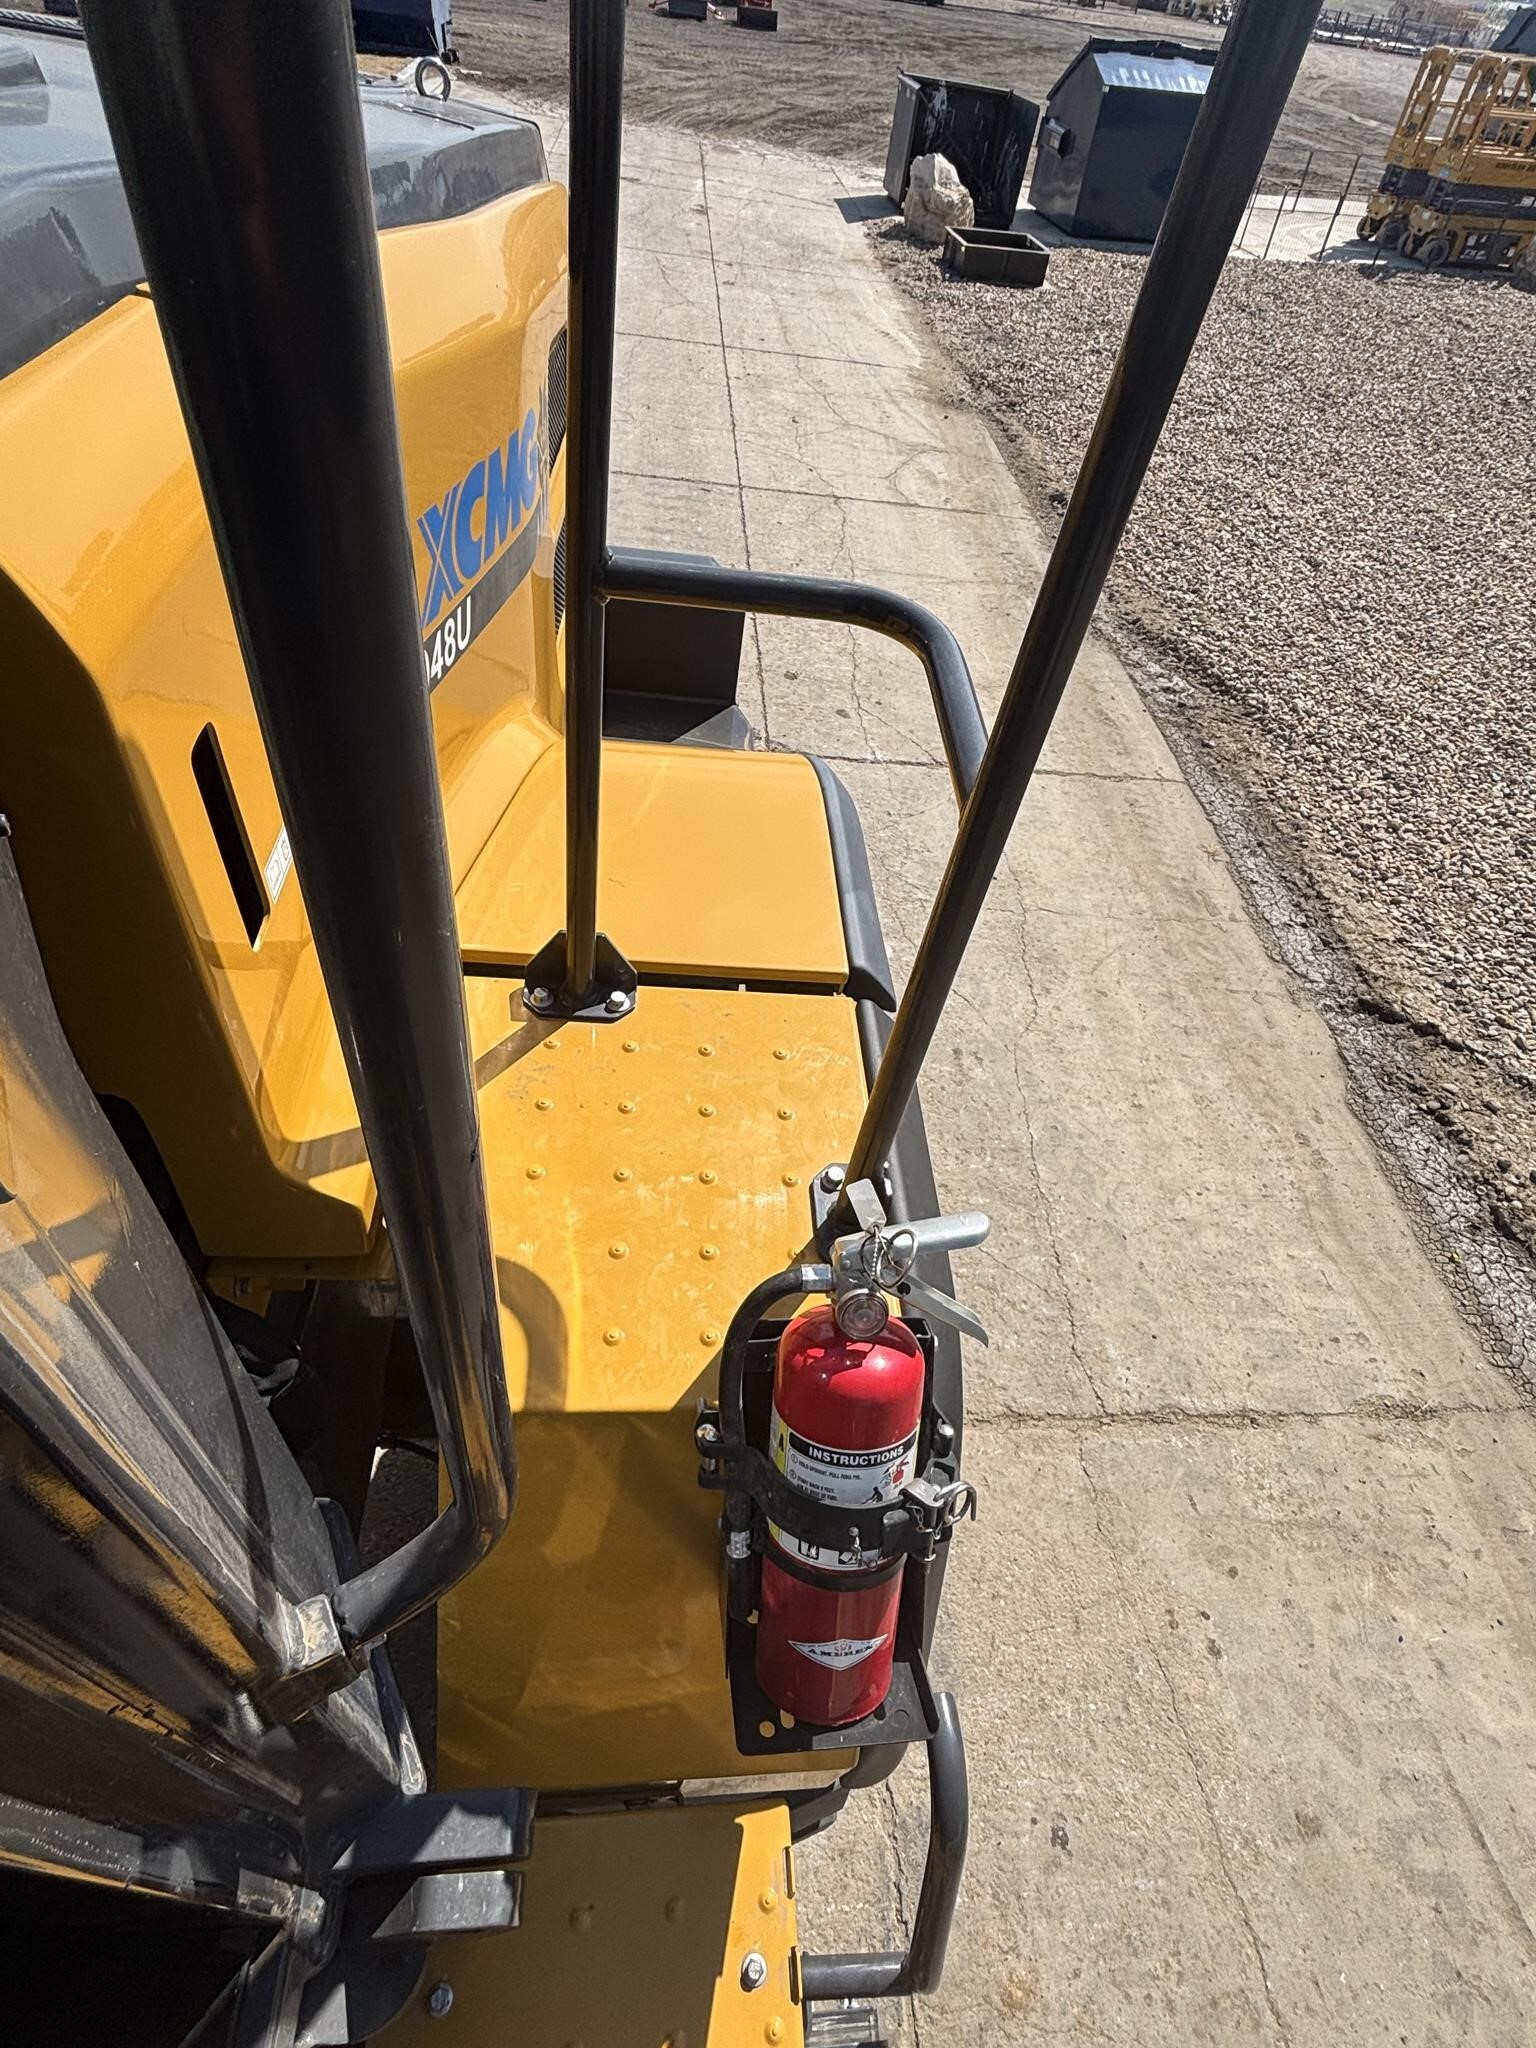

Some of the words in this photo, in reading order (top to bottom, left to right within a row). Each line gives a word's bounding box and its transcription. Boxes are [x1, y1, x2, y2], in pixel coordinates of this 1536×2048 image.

[417, 408, 538, 627] XCMG
[424, 595, 472, 686] 48U
[809, 1446, 904, 1465] INSTRUCTIONS
